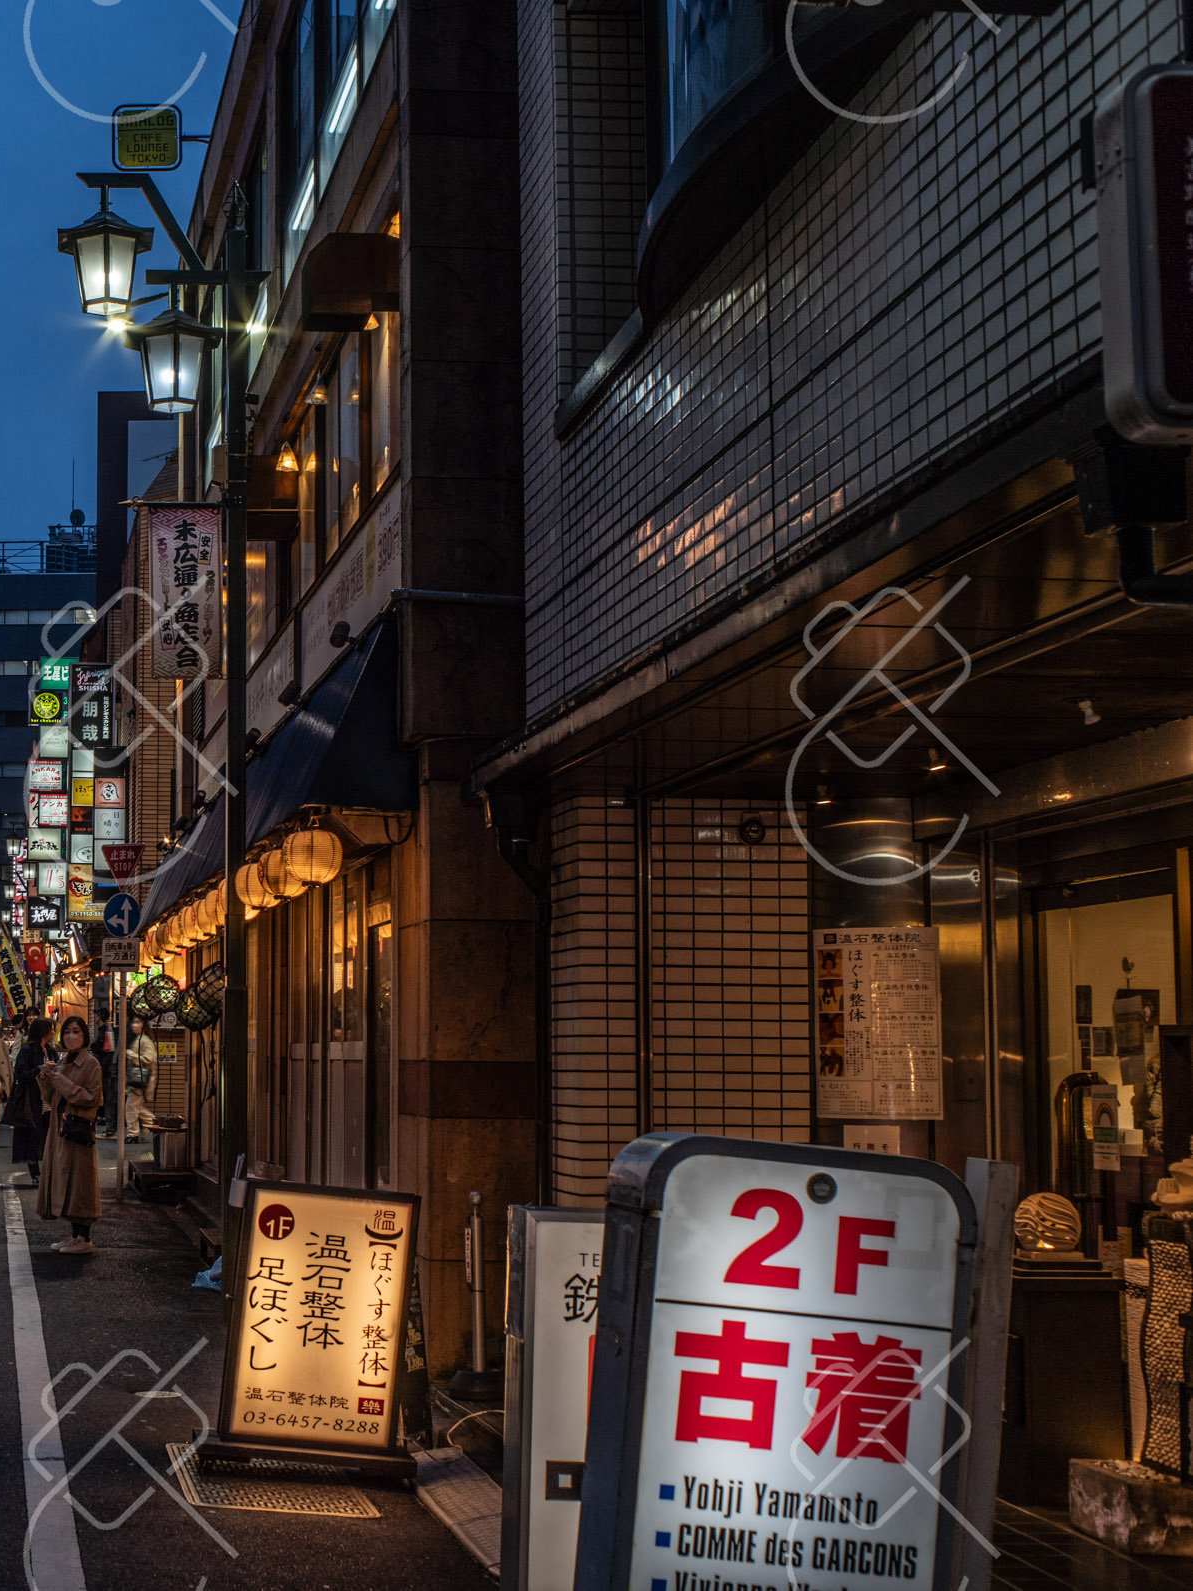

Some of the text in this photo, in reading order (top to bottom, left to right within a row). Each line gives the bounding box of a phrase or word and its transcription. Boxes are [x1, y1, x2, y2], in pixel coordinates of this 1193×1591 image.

[126, 143, 169, 152] LOUNGE
[133, 133, 162, 142] CAFE
[131, 153, 166, 162] TOKYO
[173, 519, 199, 668] 末広通り商店会
[31, 766, 61, 776] ANKARA
[110, 850, 136, 861] 止まれ
[114, 863, 133, 872] STOP
[839, 933, 921, 944] 温石整体院
[105, 951, 136, 960] 一方通行
[848, 950, 866, 1023] ほぐす整体
[266, 1216, 293, 1239] 1F
[724, 1187, 896, 1295] 2F
[296, 1231, 352, 1350] 温石整体
[247, 1256, 294, 1371] 足ほぐし
[244, 1386, 350, 1410] 温石整体院
[673, 1319, 922, 1464] 古着
[242, 1410, 380, 1435] 03-6457-8288
[683, 1475, 879, 1527] Yohji Yamamoto
[677, 1523, 918, 1580] COMME des GARCONS
